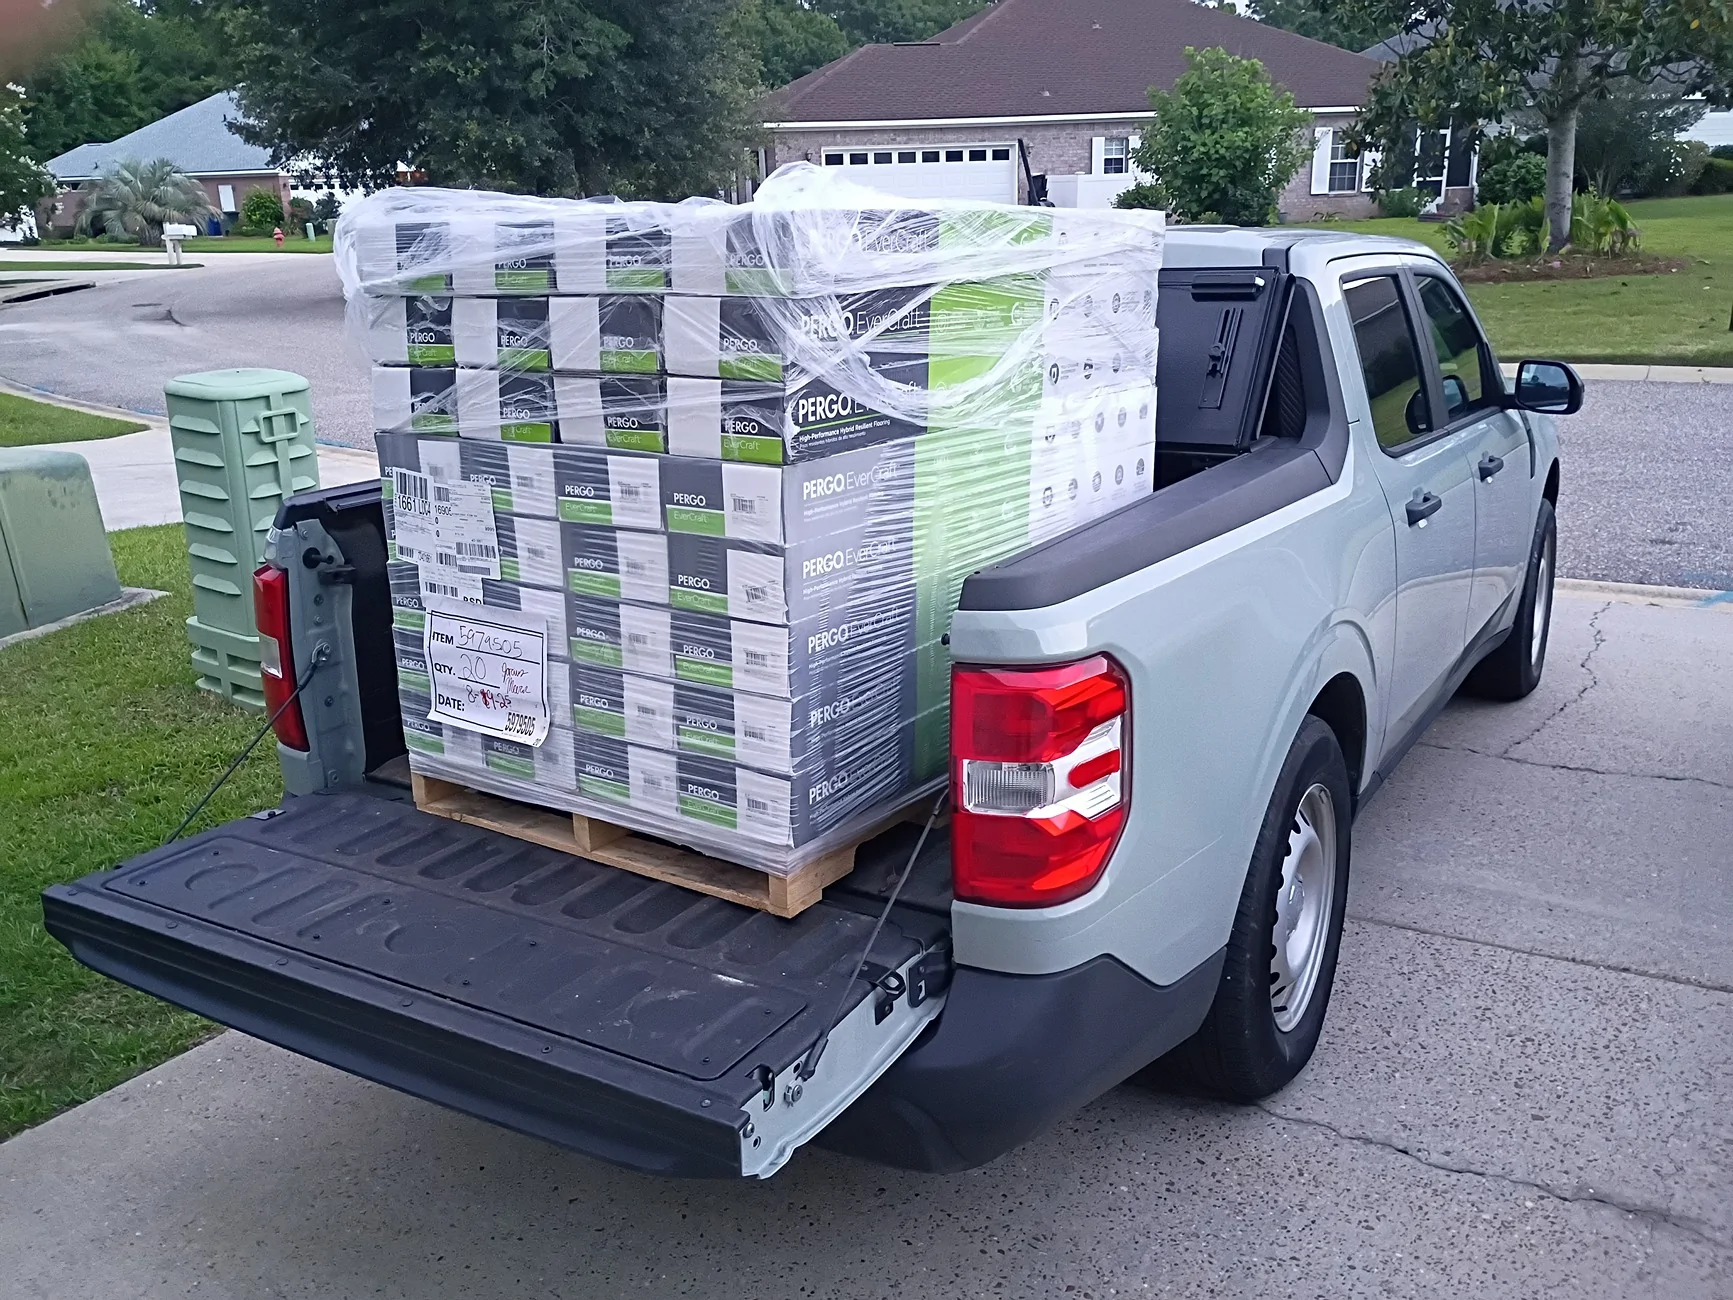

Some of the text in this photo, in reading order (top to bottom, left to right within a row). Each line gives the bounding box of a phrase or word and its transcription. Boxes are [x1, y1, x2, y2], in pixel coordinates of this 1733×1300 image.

[501, 335, 528, 347] PERGO
[603, 336, 634, 348] PERGO
[723, 338, 758, 351] PERGO
[502, 407, 530, 419] PERGO
[798, 393, 852, 425] PERGO
[607, 416, 639, 429] PERGO
[725, 420, 758, 434] PERGO
[840, 426, 855, 435] Hybrid
[855, 422, 873, 430] Resilient
[873, 419, 891, 428] Flooring
[607, 432, 642, 444] EverCraft
[723, 438, 760, 451] EverCraft
[803, 462, 897, 500] PERGO EverCraft
[564, 485, 595, 498] PERGO
[398, 495, 416, 512] 1661
[673, 492, 706, 507] PERGO
[565, 502, 597, 513] EverCraft
[673, 510, 709, 523] EverCraft
[574, 557, 604, 570] PERGO
[802, 550, 844, 580] PERGO
[678, 574, 710, 589] PERGO
[396, 597, 419, 608] PERGO
[677, 592, 711, 605] EverCraft
[432, 631, 454, 645] ITEM
[576, 626, 606, 640] PERGO
[808, 624, 848, 654] PERGO
[683, 644, 715, 659] PERGO
[401, 658, 425, 669] PERGO
[434, 662, 456, 676] QTY.
[460, 653, 487, 681] 20
[438, 694, 465, 712] DATE:
[580, 694, 609, 709] PERGO
[504, 711, 536, 737] 5979505
[686, 716, 718, 730] PERGO
[585, 764, 614, 778] PERGO
[687, 783, 720, 800] PERGO
[809, 771, 848, 805] PERGO
